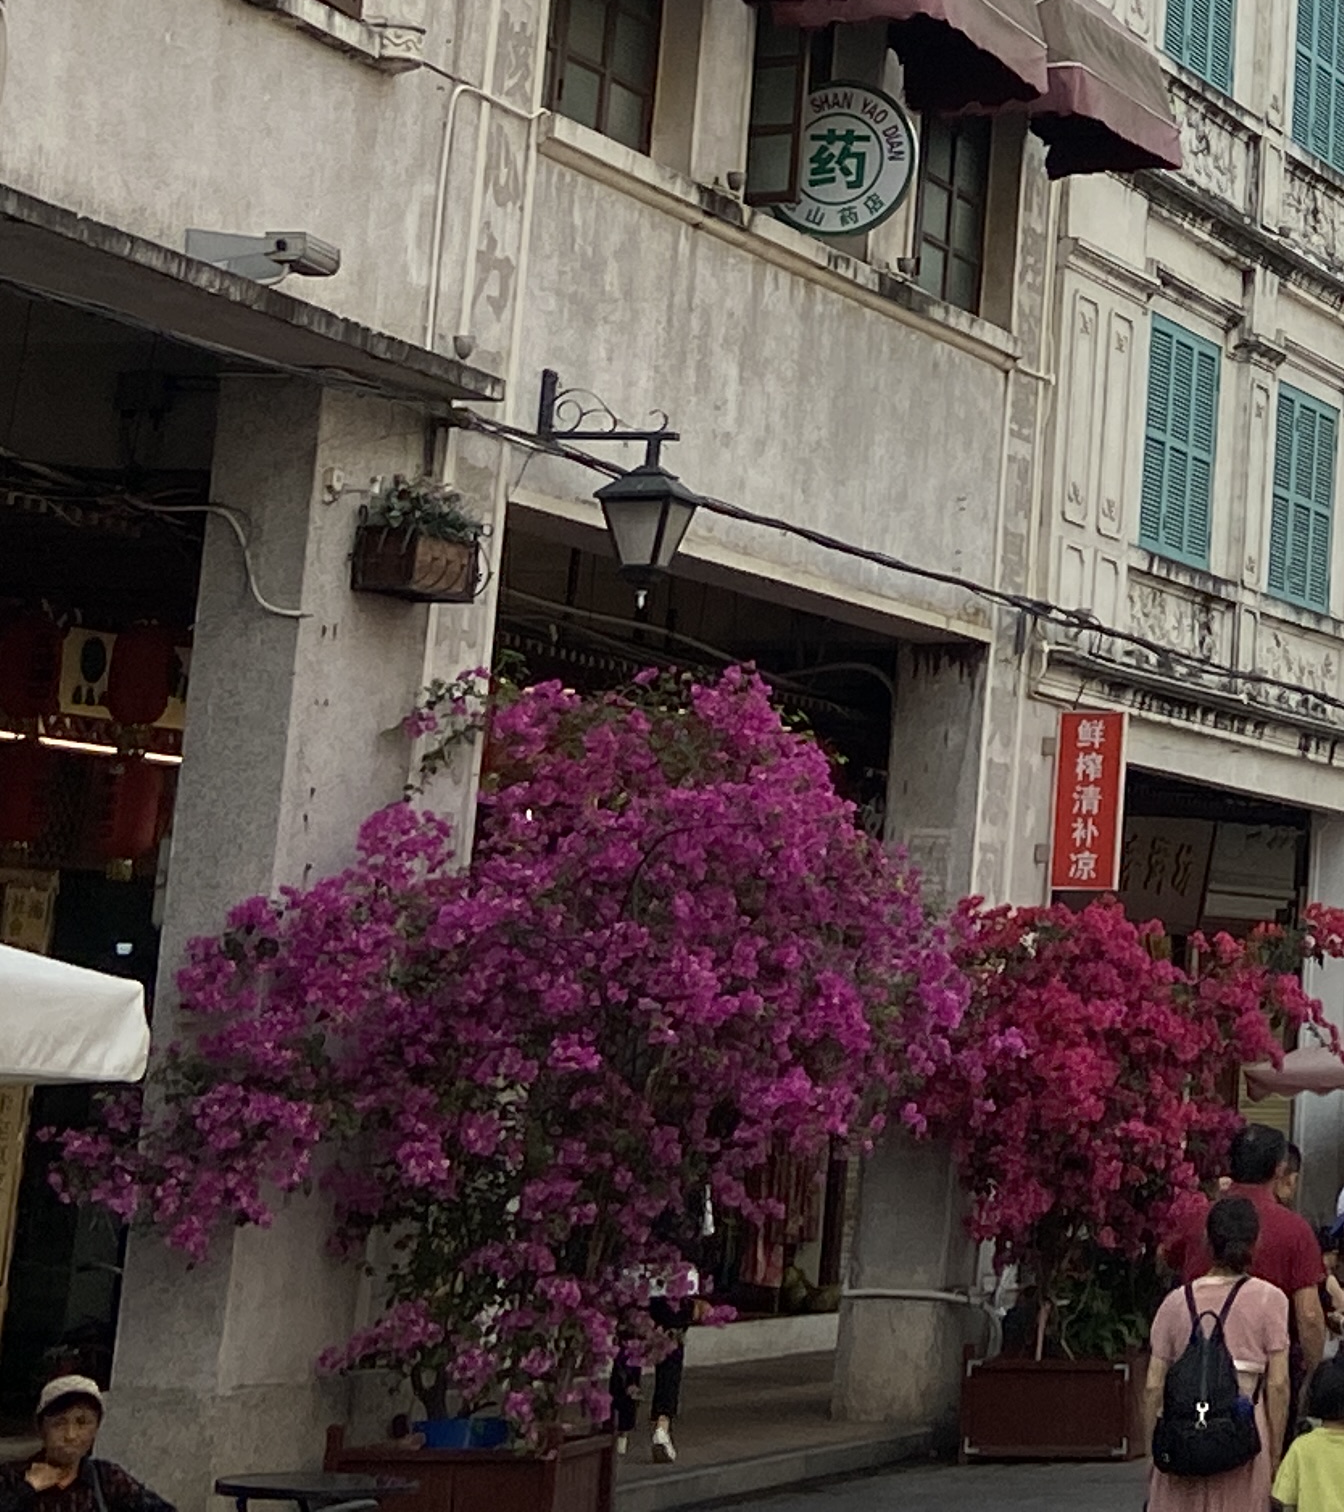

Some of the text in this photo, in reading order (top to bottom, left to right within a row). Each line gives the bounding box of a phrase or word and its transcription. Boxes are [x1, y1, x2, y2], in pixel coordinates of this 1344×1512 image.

[809, 128, 871, 189] 药
[811, 92, 905, 161] SHAN YAO DIAN
